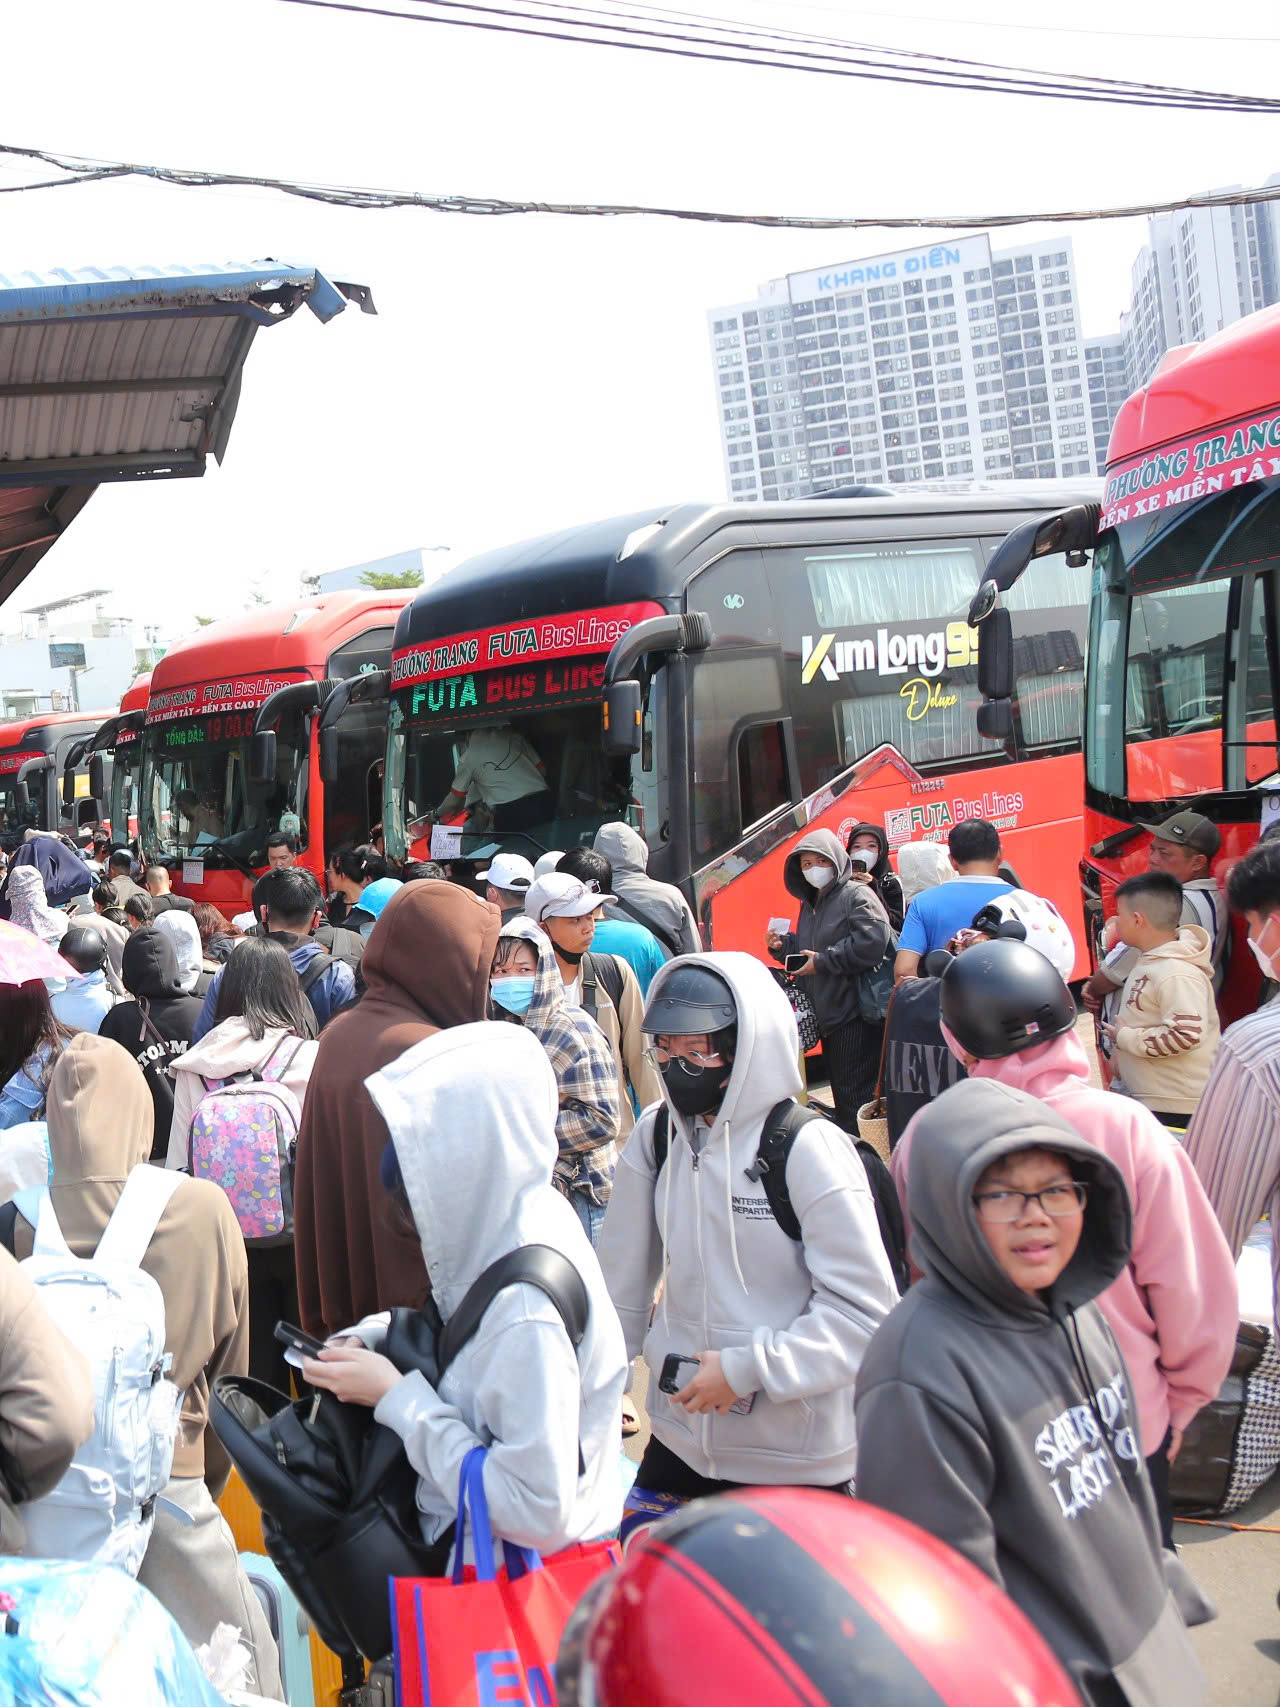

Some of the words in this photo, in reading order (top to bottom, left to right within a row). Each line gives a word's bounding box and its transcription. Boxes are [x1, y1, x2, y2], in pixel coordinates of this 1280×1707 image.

[817, 261, 898, 291] KHANG
[1104, 448, 1189, 507] PHƯƠNG
[1097, 502, 1131, 534] BẾN
[1132, 494, 1161, 518] XE
[1165, 470, 1225, 507] MIỀN
[432, 638, 479, 672] TRANG
[487, 628, 539, 660] FUTA
[540, 624, 577, 651] Bus
[576, 617, 632, 646] Lines
[201, 701, 219, 714] BẾN
[220, 702, 233, 712] XE
[234, 700, 255, 710] CAO
[203, 683, 234, 701] FUTA
[234, 681, 257, 697] Bus
[412, 674, 478, 715] FUTA
[545, 662, 606, 695] Line
[899, 678, 958, 721] Deluxe
[910, 801, 953, 833] FUTA
[953, 797, 983, 823] Bus
[983, 791, 1024, 817] Lines
[1048, 1448, 1112, 1520] LAST
